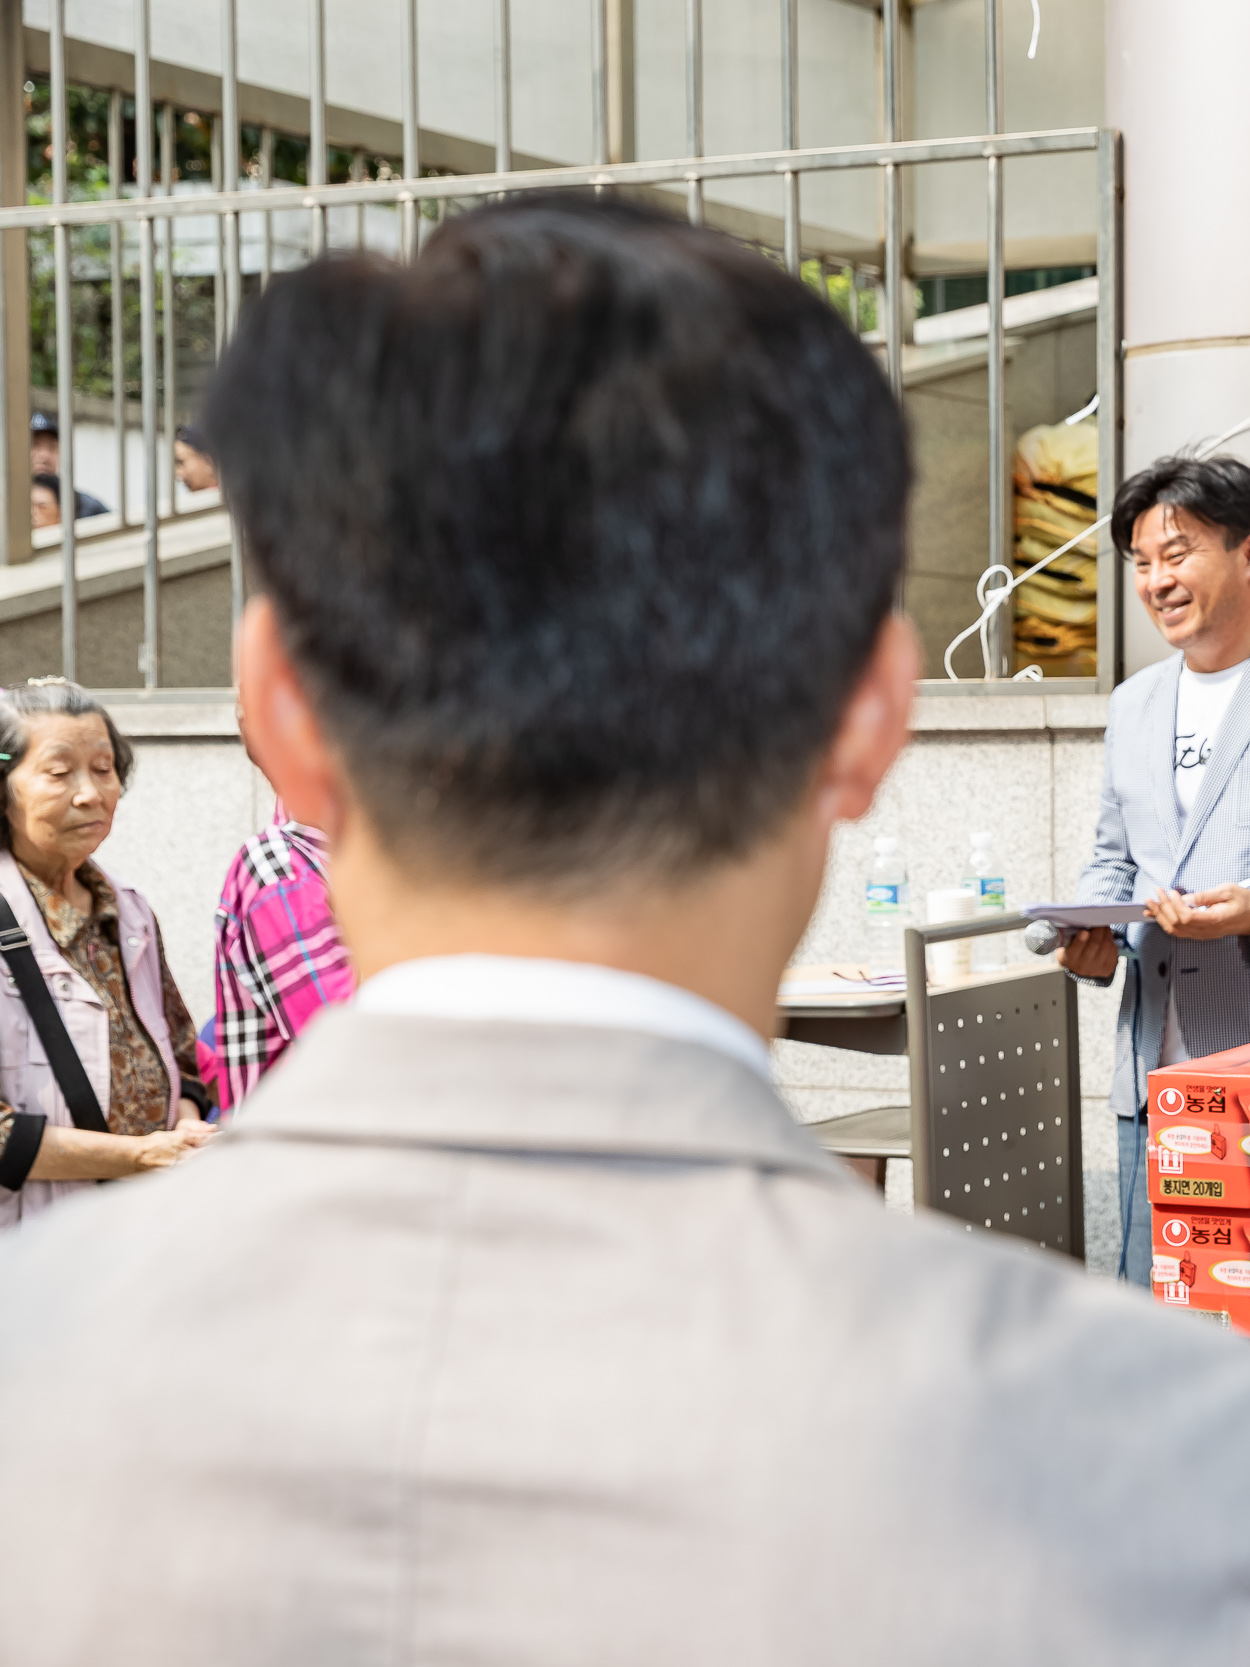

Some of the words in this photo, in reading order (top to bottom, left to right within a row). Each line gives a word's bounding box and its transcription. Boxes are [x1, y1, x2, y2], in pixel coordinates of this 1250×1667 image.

[1186, 1094, 1226, 1113] 농심
[1163, 1178, 1190, 1196] 봉지면
[1193, 1181, 1223, 1197] 20개입
[1191, 1226, 1231, 1245] 농심
